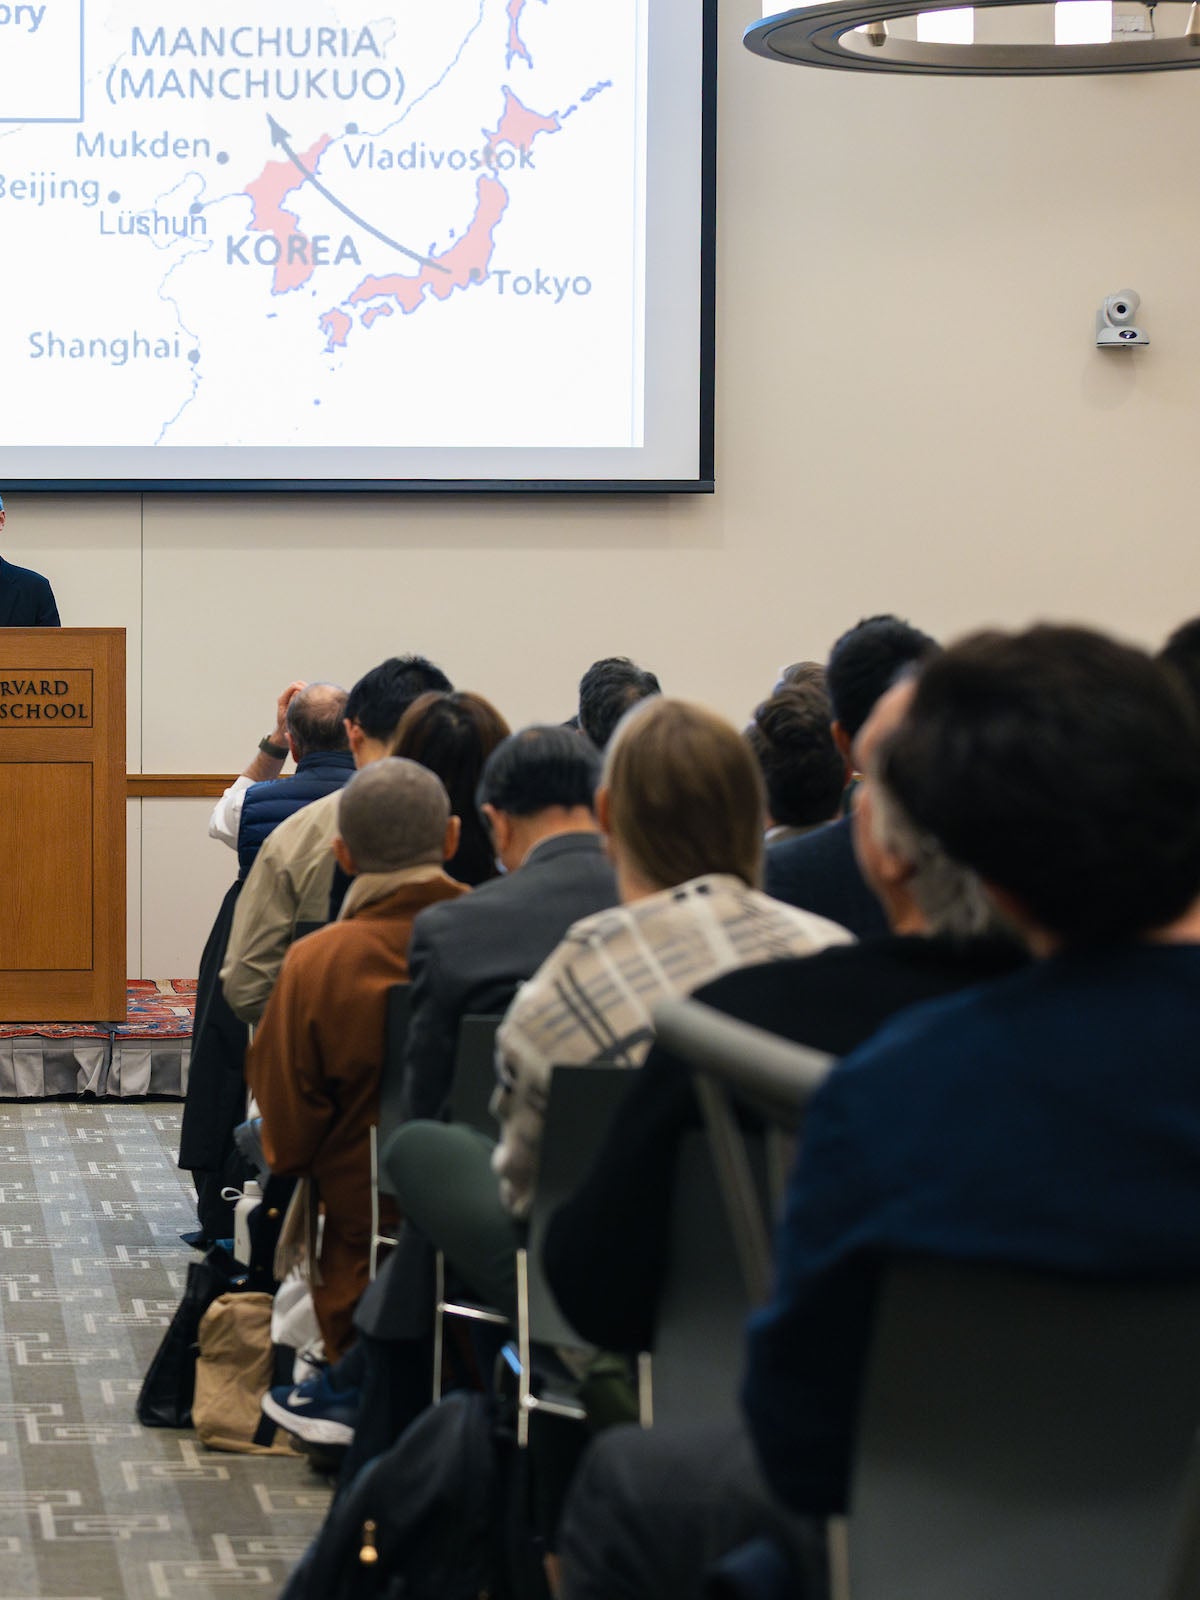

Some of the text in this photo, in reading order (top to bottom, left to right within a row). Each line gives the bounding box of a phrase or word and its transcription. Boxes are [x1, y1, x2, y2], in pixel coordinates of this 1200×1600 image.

[131, 26, 378, 58] MANCHURIA
[106, 66, 405, 104] (MANCHUKUO)
[76, 130, 210, 159] Mukden
[344, 142, 536, 171] Vladivostok
[100, 210, 207, 236] Lüshun
[226, 236, 361, 266] KOREA
[492, 270, 592, 303] Tokyo
[28, 330, 180, 366] Shanghai
[0, 703, 88, 719] SCHOOL
